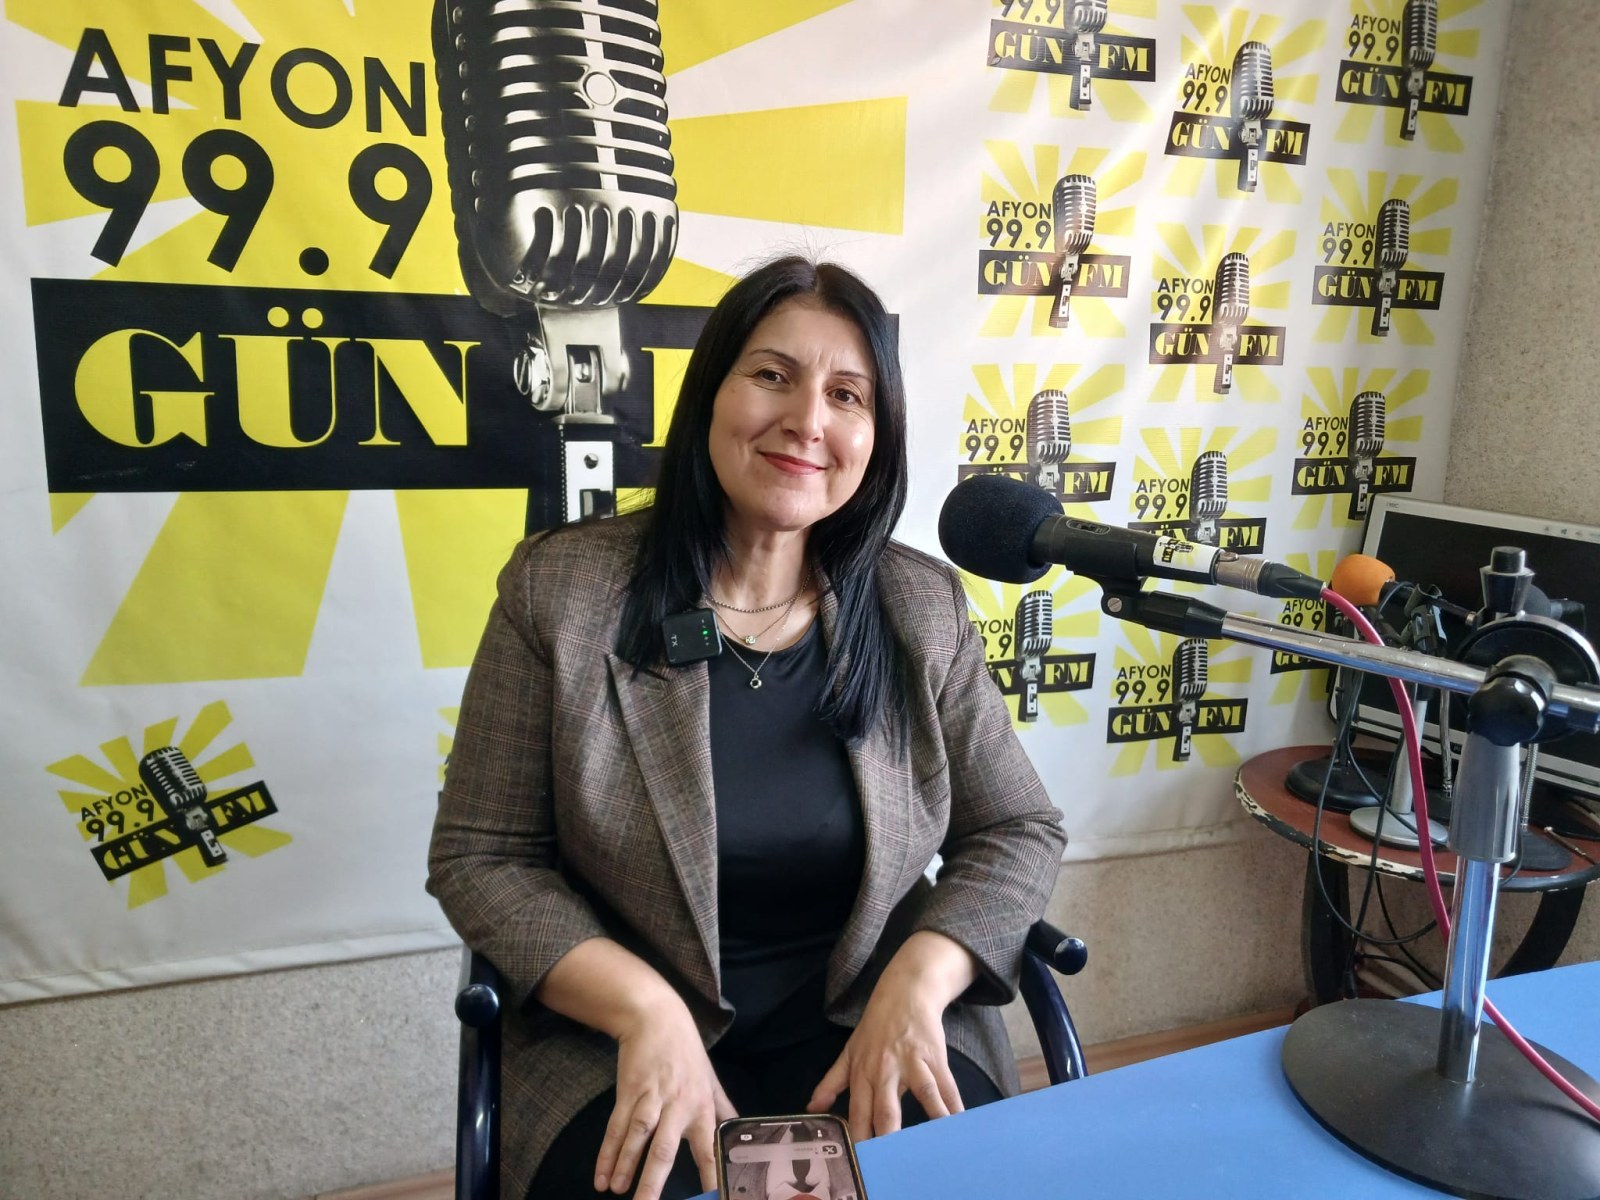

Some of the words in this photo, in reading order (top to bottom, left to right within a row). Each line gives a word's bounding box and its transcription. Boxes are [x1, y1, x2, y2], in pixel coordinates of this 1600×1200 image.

[1351, 13, 1402, 35] AFYON
[994, 28, 1066, 64] GÜN
[1098, 43, 1151, 73] FM
[1348, 30, 1399, 62] 99.9
[58, 27, 426, 137] AFYON
[1185, 62, 1231, 85] AFYON
[1341, 67, 1402, 99] GÜN
[1424, 80, 1466, 107] FM
[1182, 80, 1228, 113] 99.9
[1172, 119, 1233, 150] GÜN
[1265, 128, 1305, 156] FM
[63, 119, 433, 281] 99.9
[987, 200, 1052, 219] AFYON
[986, 217, 1051, 249] 99.9
[1323, 222, 1376, 239] AFYON
[1322, 237, 1374, 265] 99.9
[983, 254, 1055, 287] GÜN
[1077, 263, 1124, 289] FM
[1157, 278, 1214, 294] AFYON
[1317, 270, 1374, 299] GÜN
[1397, 278, 1439, 302] FM
[1157, 293, 1211, 322] 99.9
[1155, 327, 1213, 356] GÜN
[1239, 334, 1279, 357] FM
[74, 306, 482, 449] GÜN
[966, 418, 1025, 434] AFYON
[1304, 416, 1349, 431] AFYON
[965, 434, 1024, 462] 99.9
[1302, 431, 1347, 456] 99.9
[1063, 470, 1110, 495] FM
[1136, 478, 1190, 493] AFYON
[1297, 460, 1349, 488] GÜN
[1373, 464, 1411, 486] FM
[1135, 493, 1188, 520] 99.9
[1218, 525, 1262, 548] FM
[972, 619, 1014, 634] YON
[1044, 661, 1091, 685] FM
[1117, 664, 1171, 680] AFYON
[1116, 678, 1170, 705] 99.9
[1112, 708, 1173, 736] GÜN
[1197, 705, 1244, 727] FM
[80, 784, 148, 822] AFYON
[86, 798, 154, 842] 99.9
[103, 823, 181, 870] GÜN
[211, 790, 267, 828] FM
